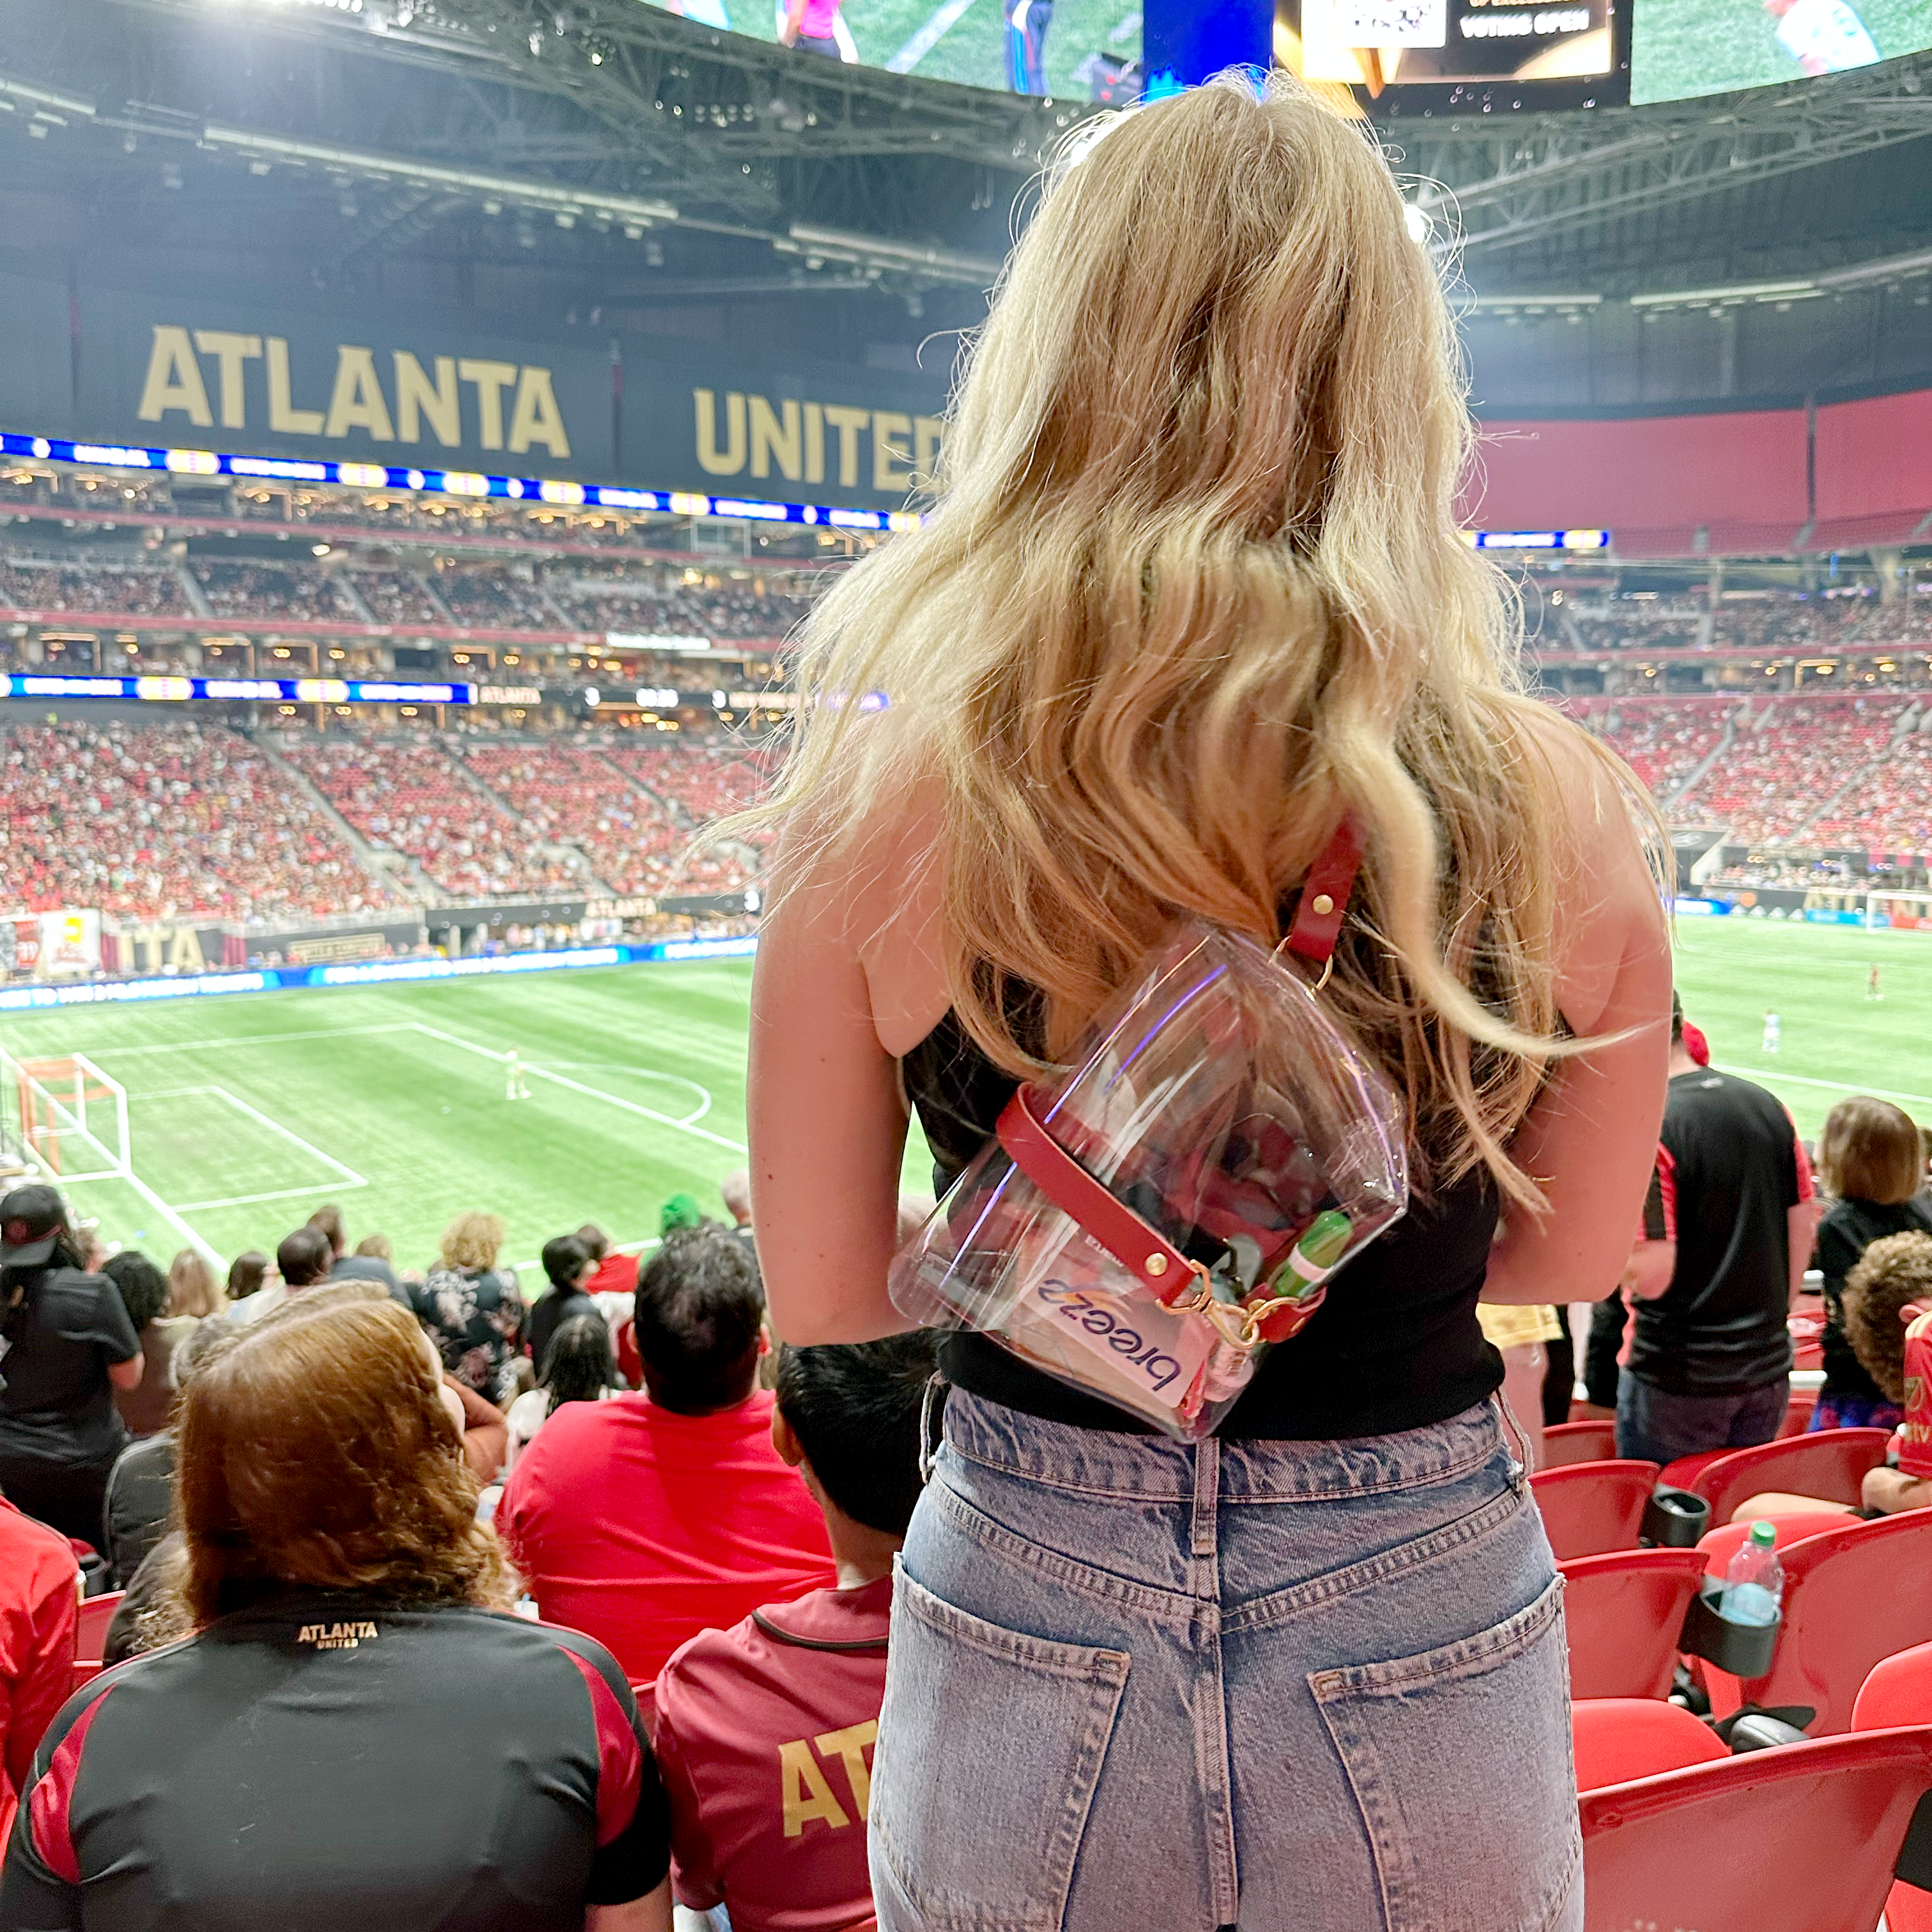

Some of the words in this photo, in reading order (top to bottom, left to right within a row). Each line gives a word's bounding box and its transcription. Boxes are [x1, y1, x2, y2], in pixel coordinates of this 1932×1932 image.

[1459, 13, 1533, 38] VOTING
[1534, 9, 1590, 34] OPEN
[137, 325, 571, 458] ATLANTA
[1038, 1278, 1181, 1392] breeze
[296, 1621, 379, 1643] ATLANTA
[317, 1637, 359, 1650] UNITED
[778, 1719, 879, 1837] AT
